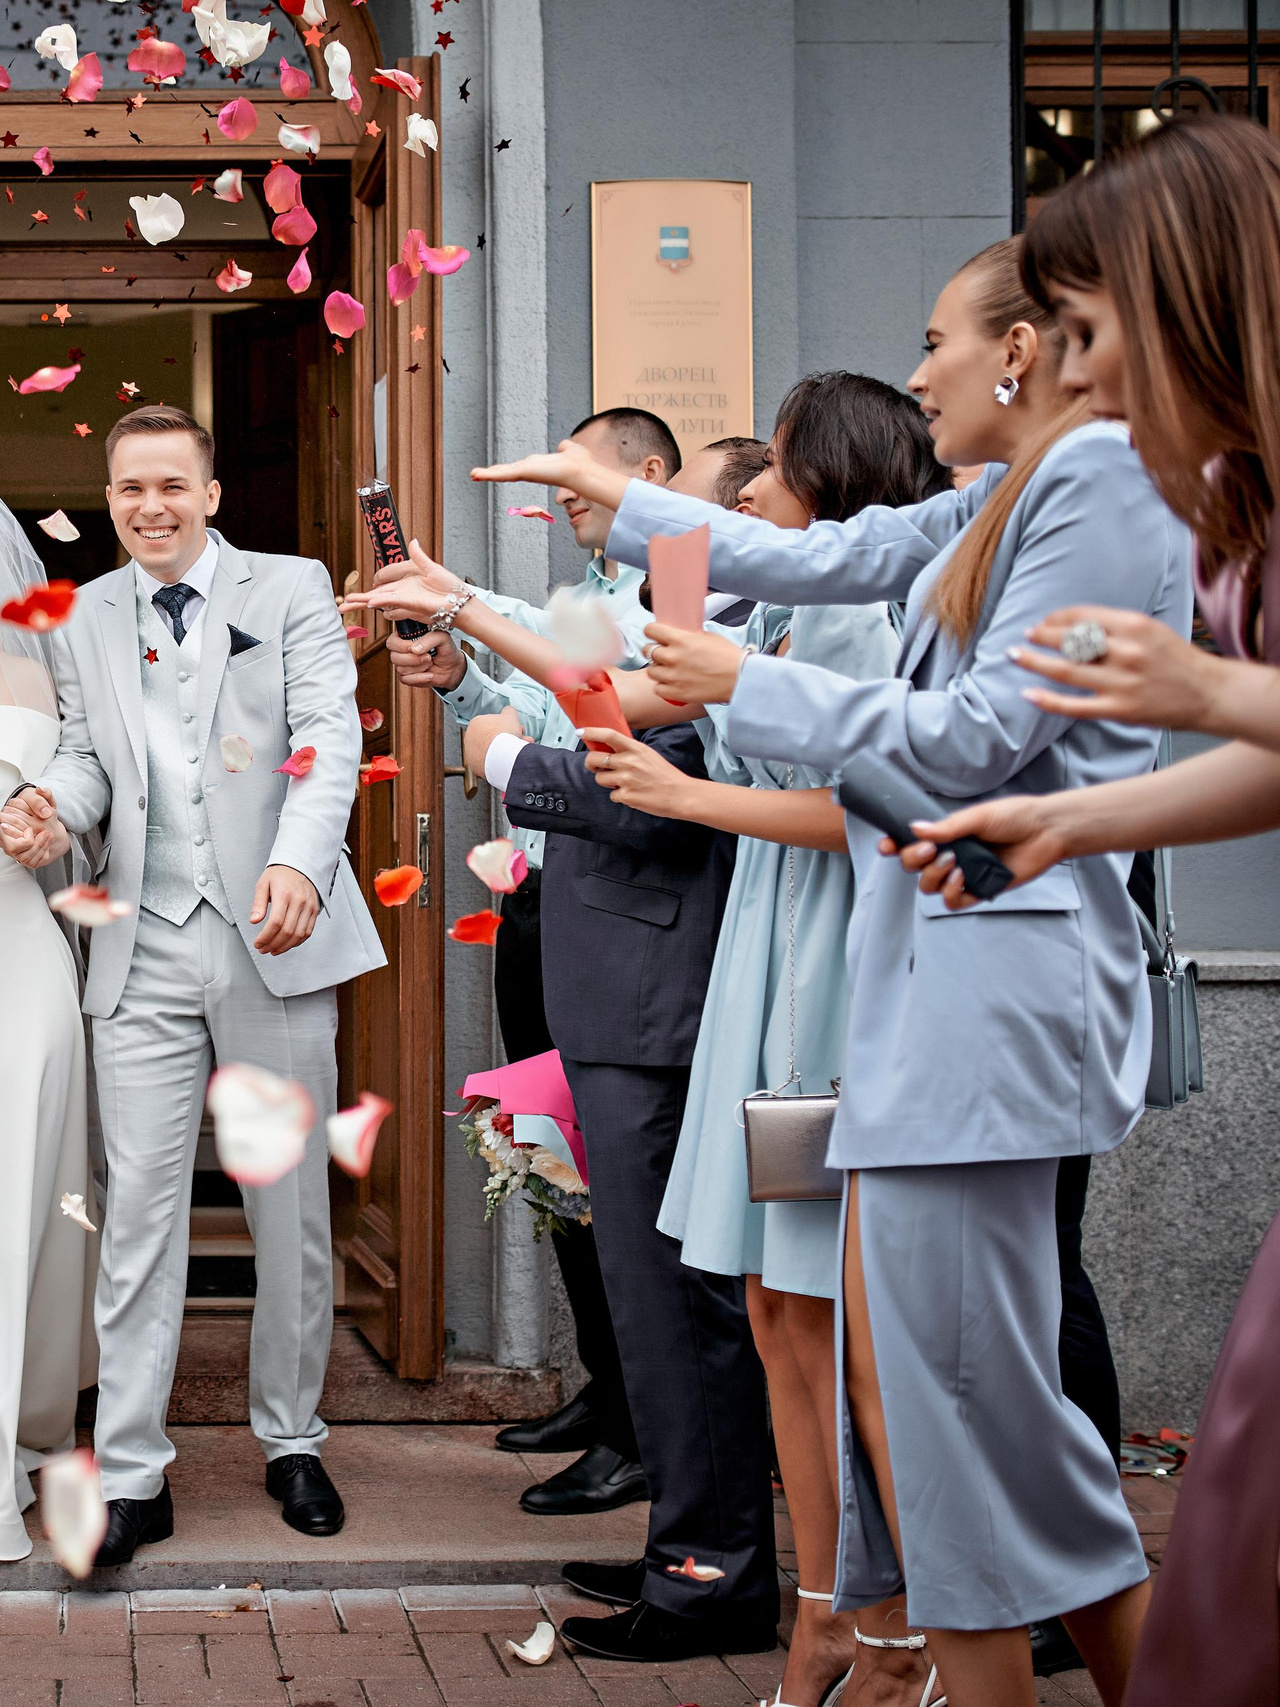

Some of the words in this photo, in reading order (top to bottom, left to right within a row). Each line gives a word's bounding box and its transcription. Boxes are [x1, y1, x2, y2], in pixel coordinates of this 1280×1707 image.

[635, 366, 716, 384] ДВОРЕЦ
[622, 392, 729, 409] ТОРЖЕСТВ
[674, 417, 725, 434] ЛУГИ
